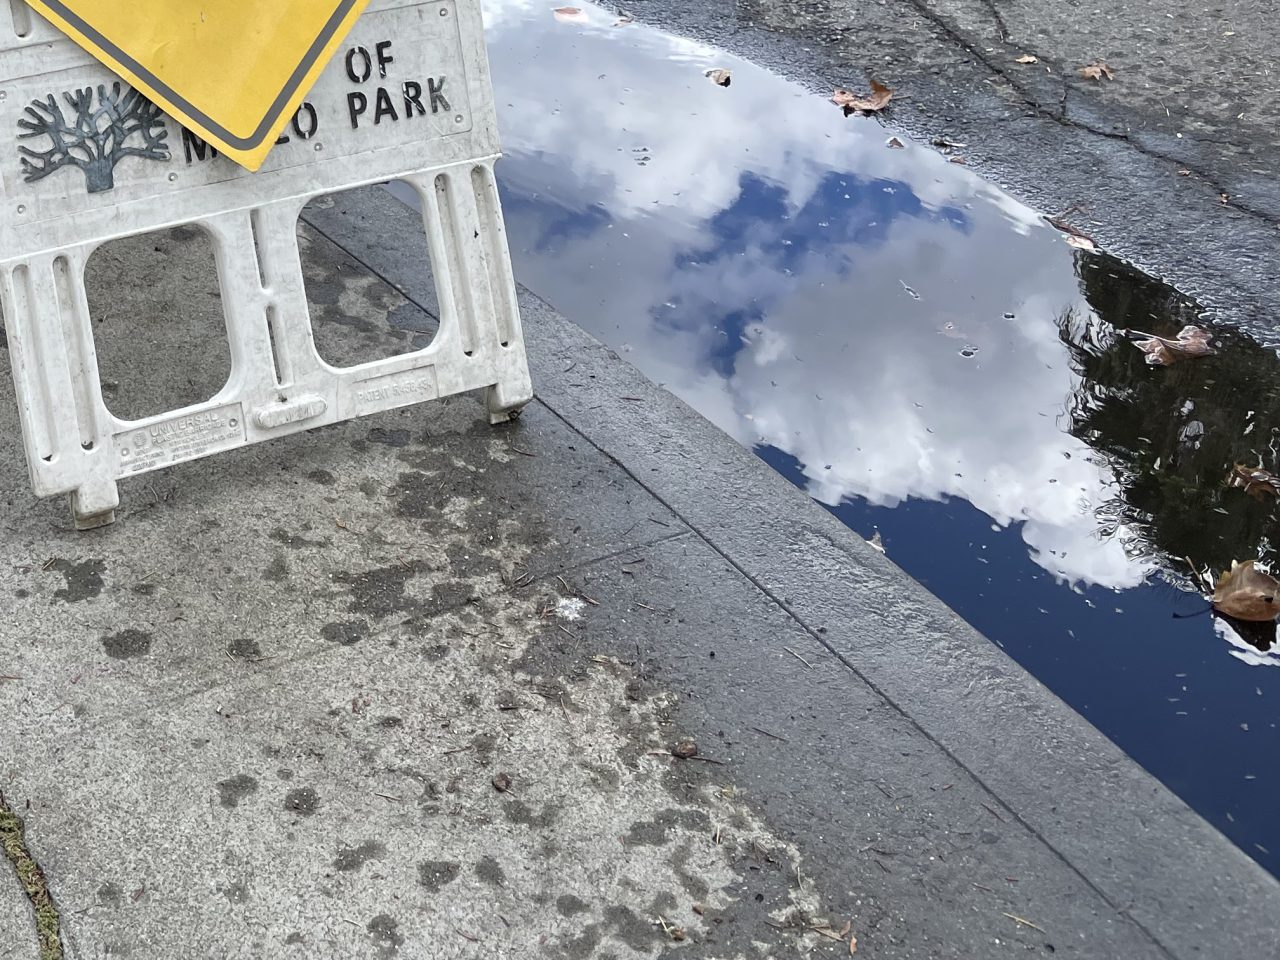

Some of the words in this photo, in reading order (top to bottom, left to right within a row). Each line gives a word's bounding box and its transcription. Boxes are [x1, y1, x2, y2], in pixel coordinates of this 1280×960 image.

[346, 41, 394, 84] OF
[347, 75, 451, 129] PARK
[358, 385, 389, 402] PATENT
[150, 411, 219, 438] UNIVERSAL
